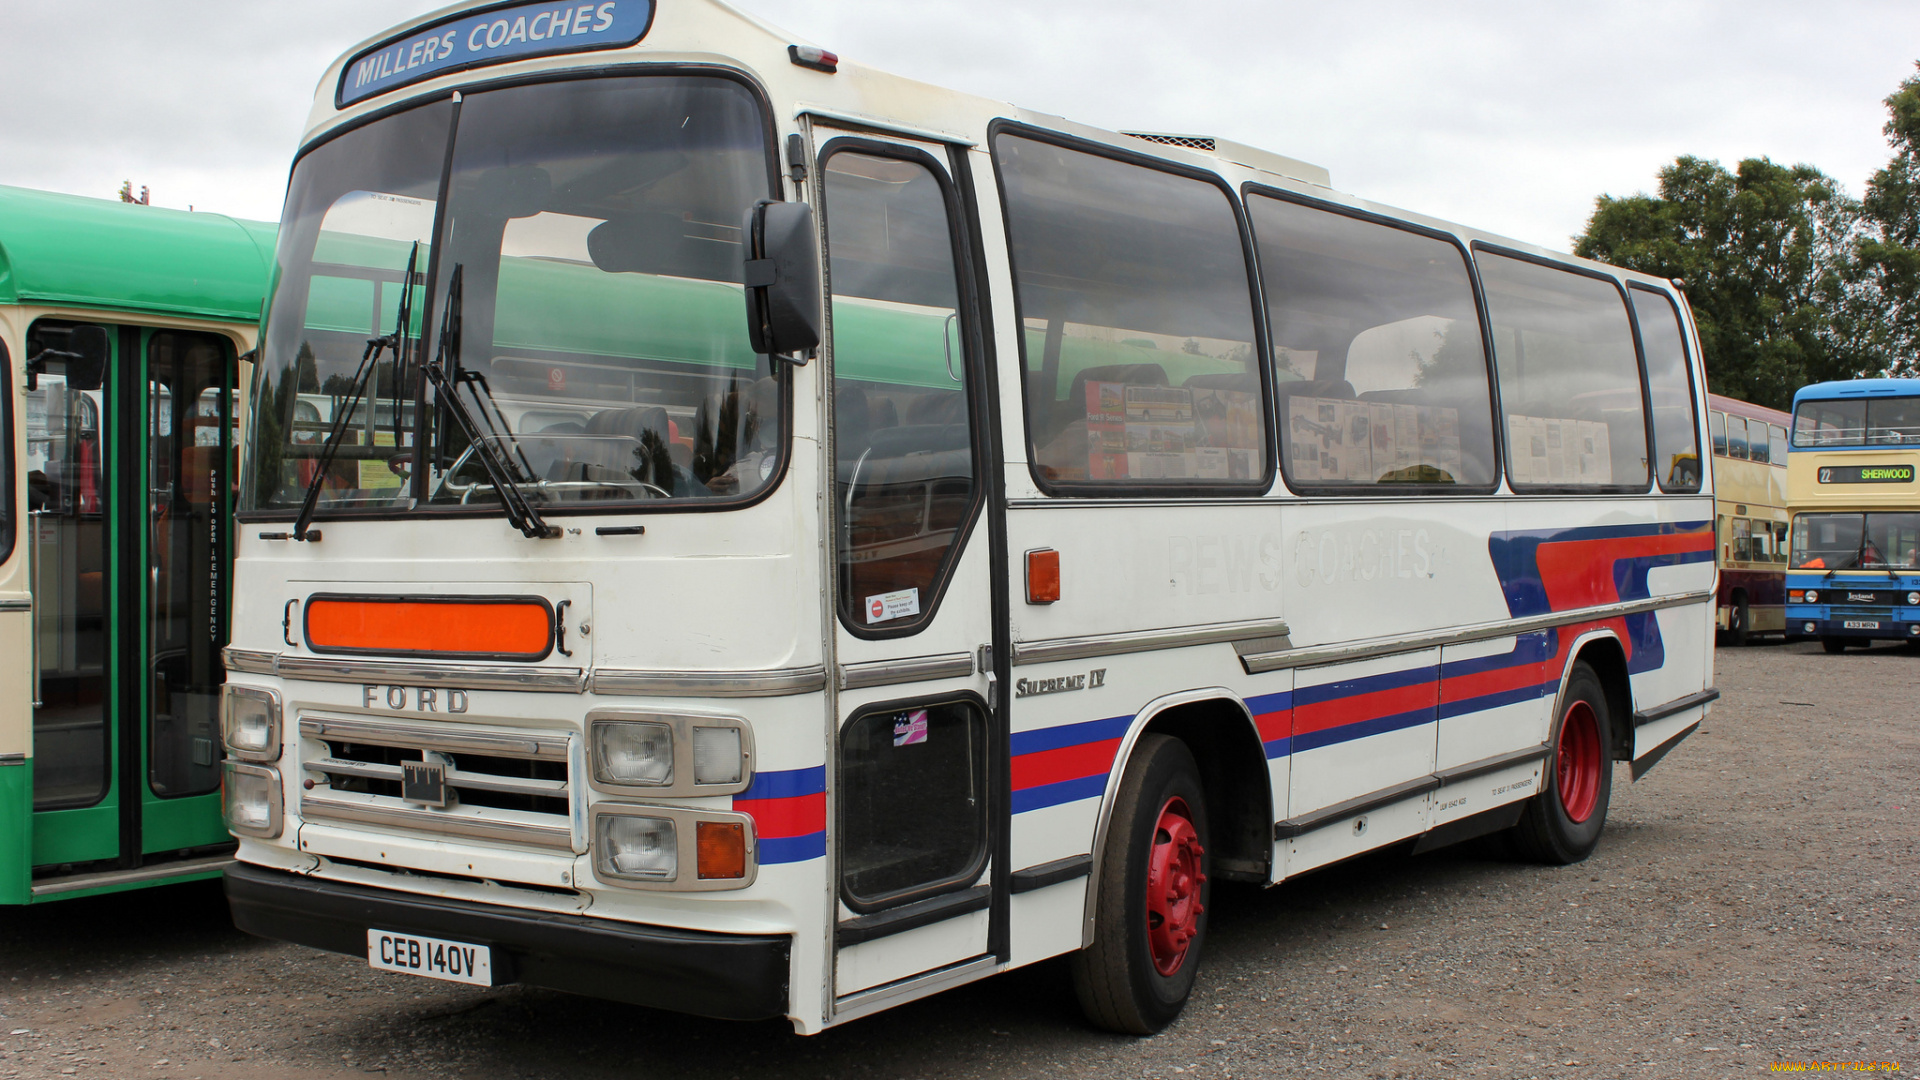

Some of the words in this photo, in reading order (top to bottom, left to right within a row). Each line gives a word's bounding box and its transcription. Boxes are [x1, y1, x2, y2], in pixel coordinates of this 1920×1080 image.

[355, 30, 457, 89] MILLERS
[467, 1, 616, 52] COACHES
[1820, 468, 1831, 483] 22
[1861, 468, 1911, 479] SHERWOOD
[209, 563, 218, 642] EMERGENCY
[1088, 668, 1107, 689] IV
[362, 684, 469, 714] FORD
[380, 935, 421, 969] CEB
[426, 942, 476, 978] 140V
